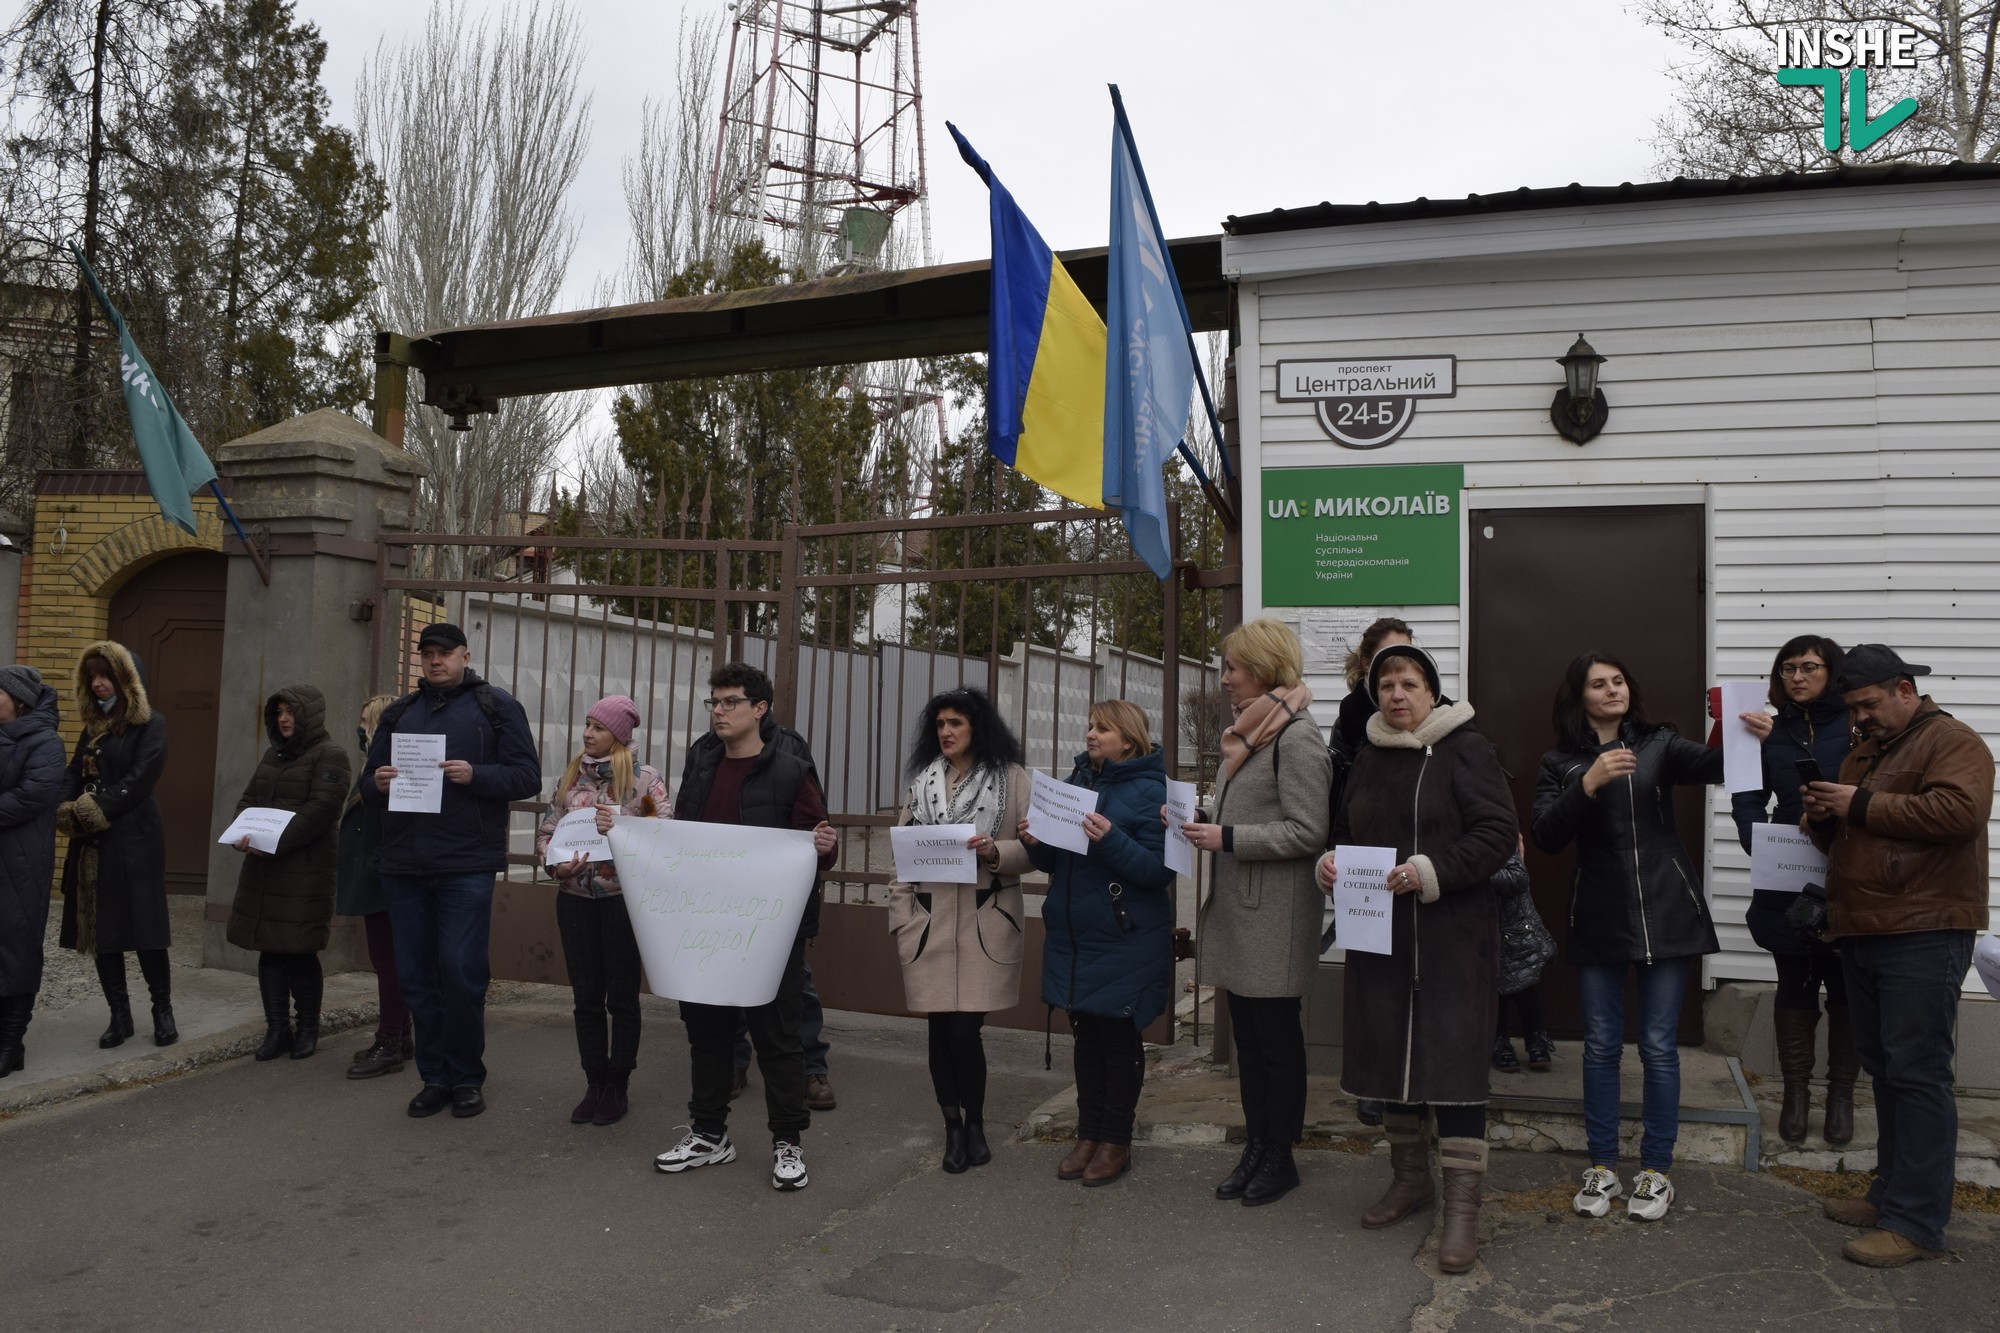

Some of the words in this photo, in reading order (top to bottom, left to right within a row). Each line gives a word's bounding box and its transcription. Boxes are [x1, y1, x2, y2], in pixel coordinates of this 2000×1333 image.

[1338, 365, 1392, 375] проспект
[1296, 372, 1436, 395] Центральний
[1337, 401, 1394, 426] 24-Б
[1314, 491, 1451, 518] МИКОЛАЇВ
[1316, 533, 1378, 543] Національна
[1315, 546, 1363, 557] суспільна
[1316, 557, 1409, 568] телерадіокомпанія
[1315, 570, 1353, 581] України
[914, 839, 957, 847] ЗАХИСТИ
[913, 858, 963, 866] СУСПІЛЬНЕ
[1346, 868, 1385, 877] ЗАЛИШТЕ
[1343, 881, 1389, 891] СУСПІЛЬНЕ
[1348, 908, 1385, 918] РЕГІОНАХ
